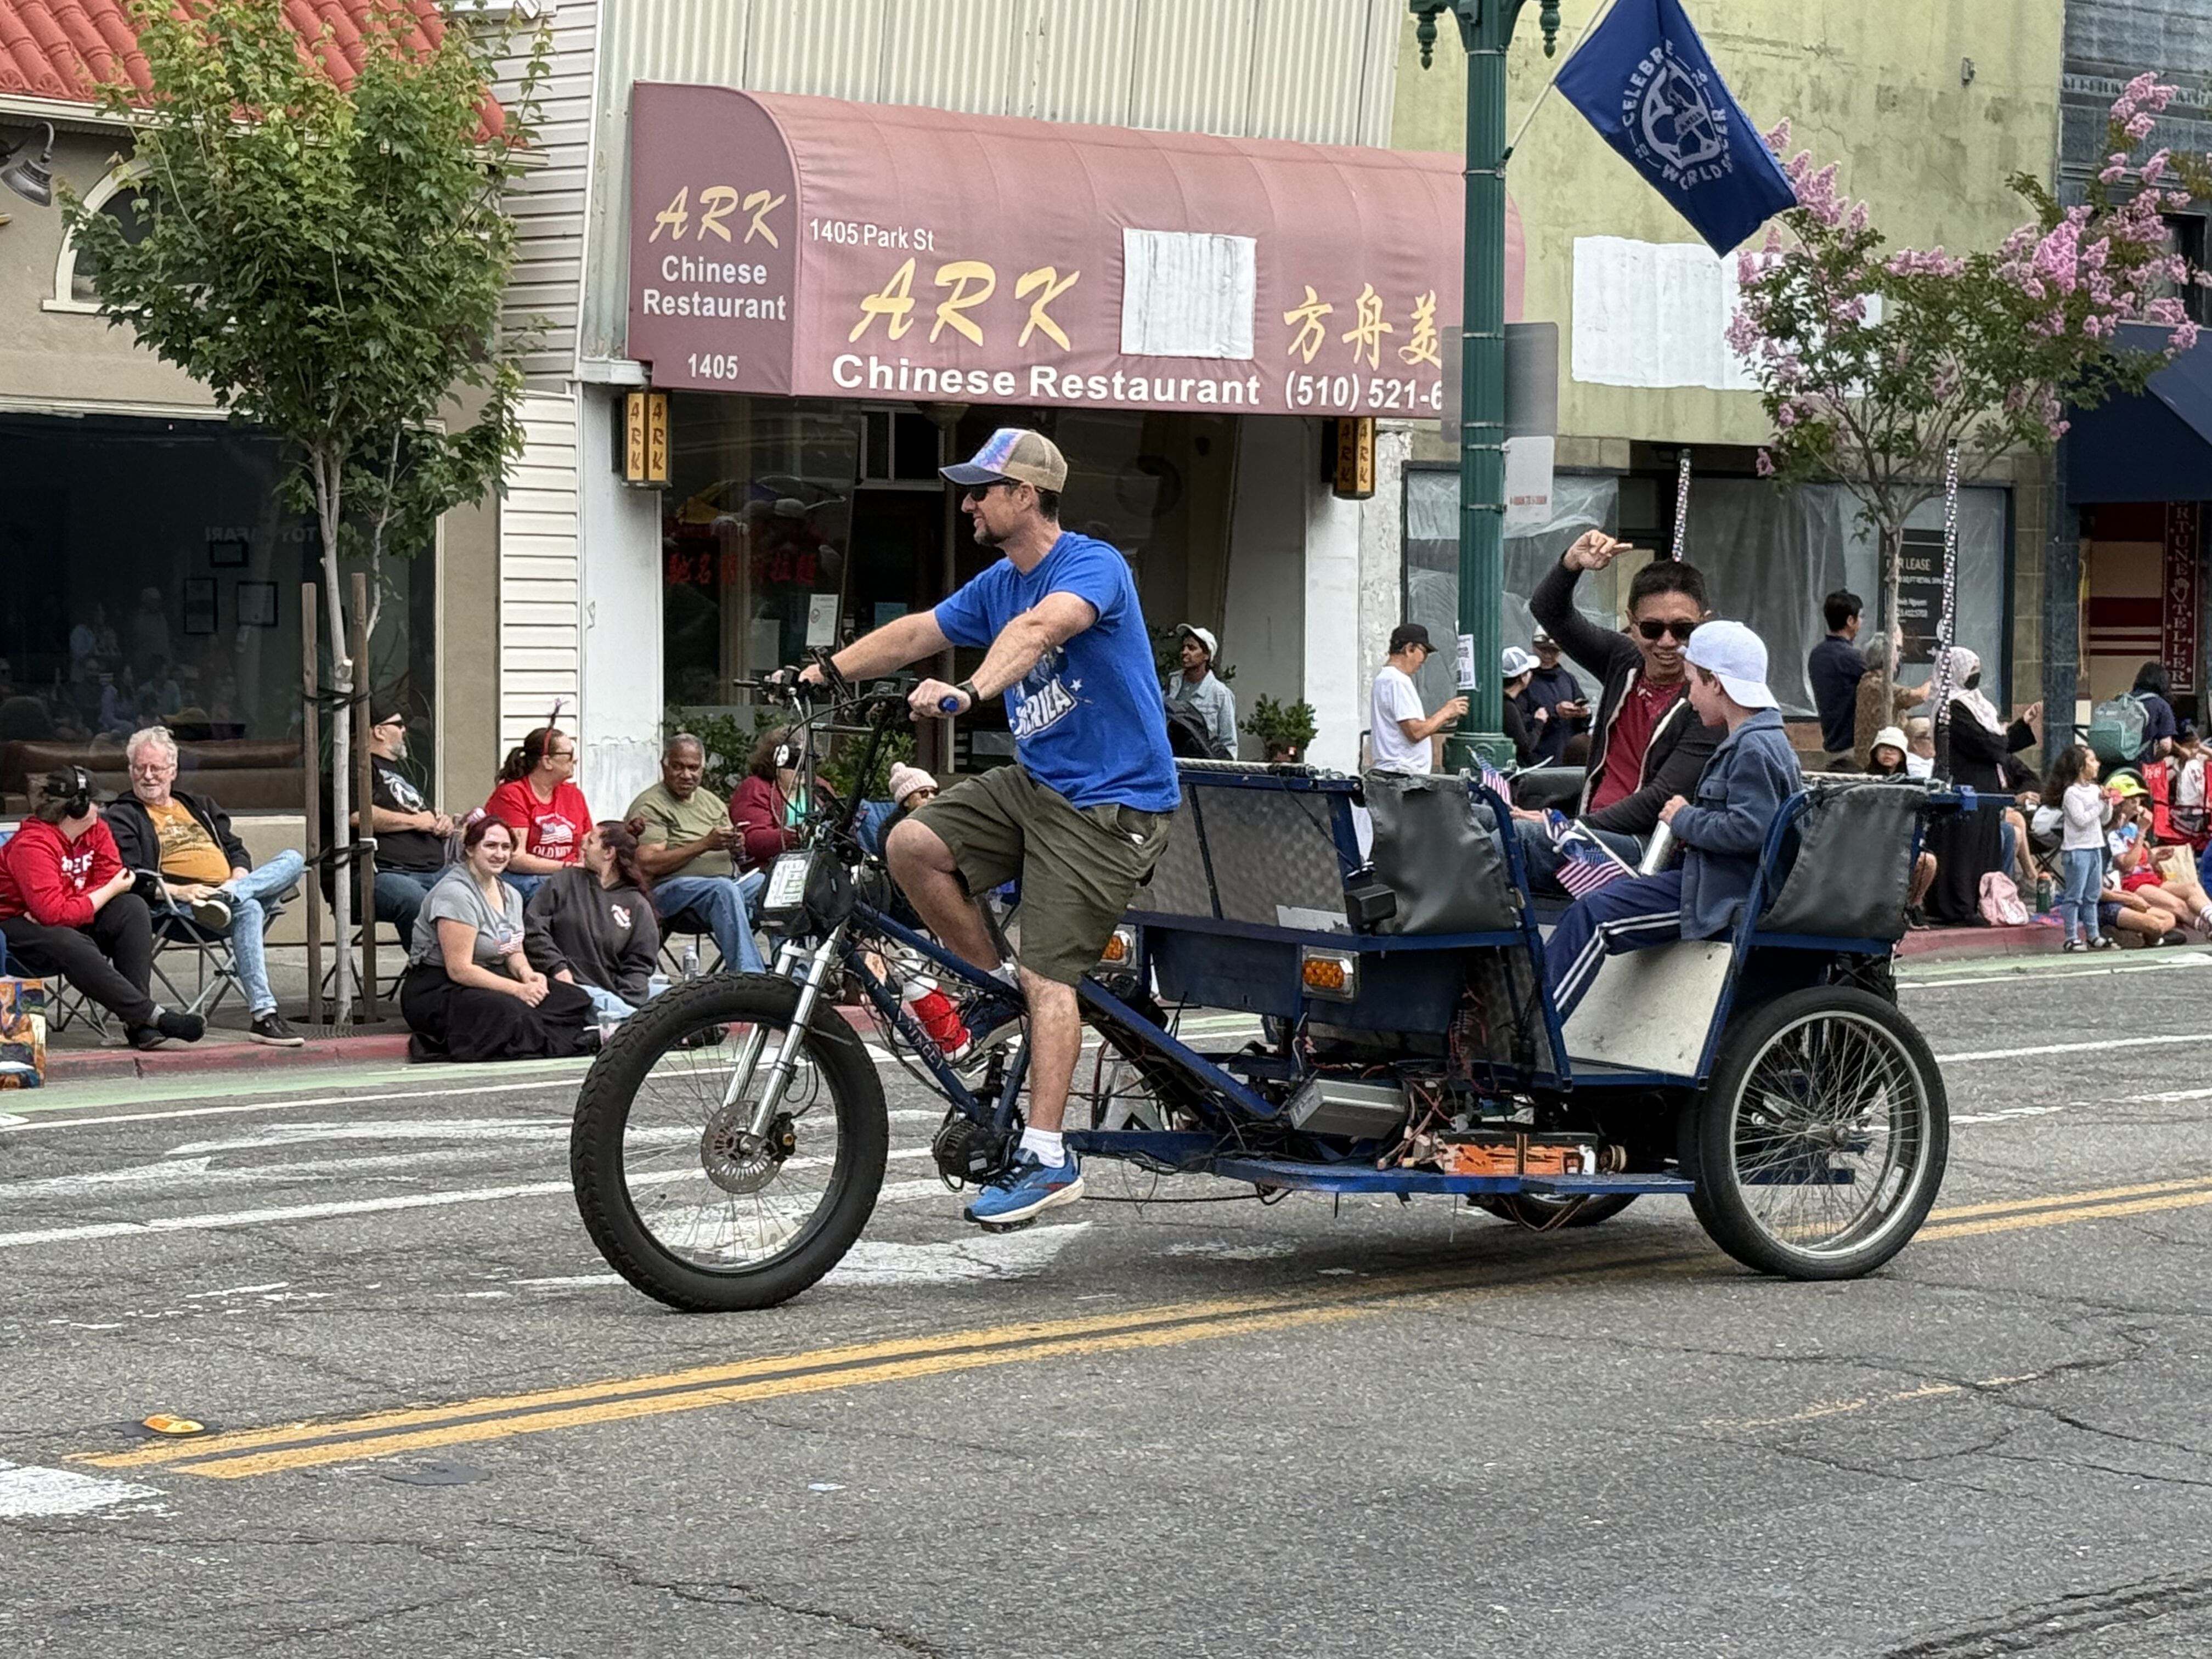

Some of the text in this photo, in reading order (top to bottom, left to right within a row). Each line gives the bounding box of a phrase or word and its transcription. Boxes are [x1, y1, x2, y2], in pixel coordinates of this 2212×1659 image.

[648, 185, 787, 249] ARK
[810, 218, 934, 252] 1405 Park St
[662, 255, 767, 285] Chinese
[643, 289, 787, 320] Restaurant
[848, 257, 1080, 352] ARK
[1283, 283, 1442, 371] 方舟美
[688, 353, 738, 380] 1405
[832, 354, 1015, 396] Chinese
[1029, 365, 1261, 405] Restaurant
[1285, 370, 1359, 411] (510)
[630, 402, 641, 471] ARK
[652, 402, 664, 471] ARK
[1359, 424, 1369, 484] ARK
[1905, 557, 1932, 571] LEASE
[2171, 604, 2187, 683] TELLER
